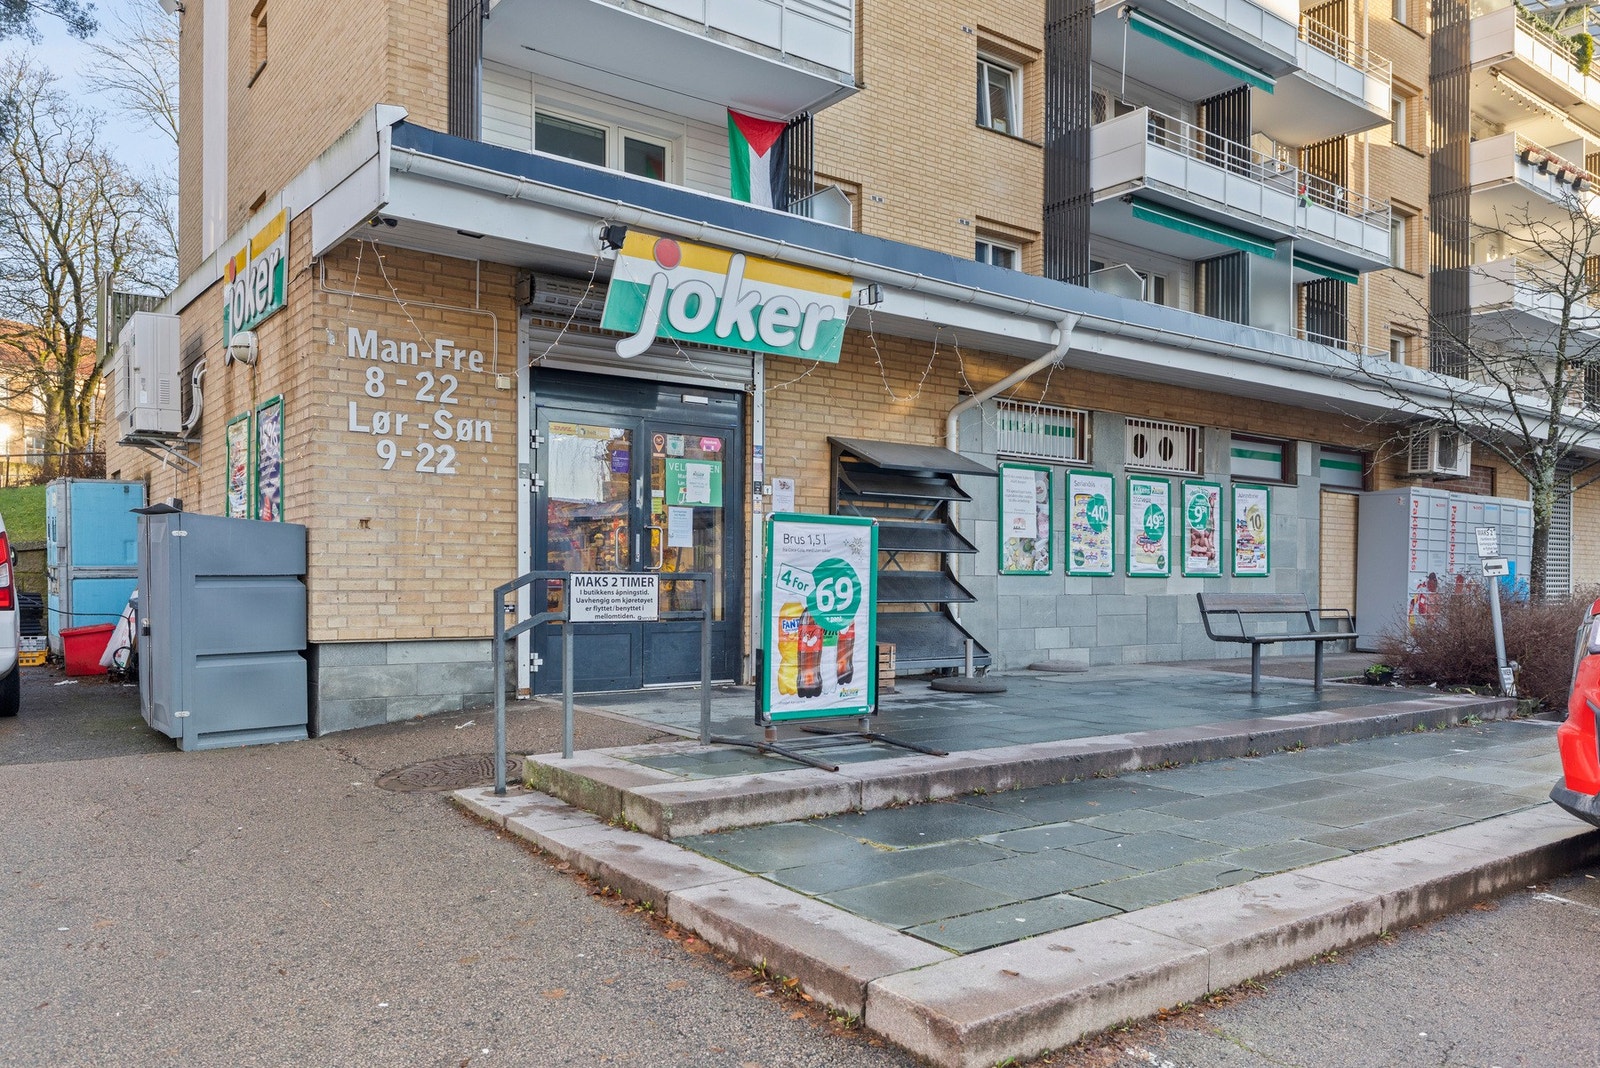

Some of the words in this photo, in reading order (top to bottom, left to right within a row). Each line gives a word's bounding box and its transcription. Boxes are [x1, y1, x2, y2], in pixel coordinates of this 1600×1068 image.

[225, 239, 280, 366] joker
[615, 238, 836, 359] joker
[783, 533, 805, 545] Brus
[808, 534, 821, 546] 1,5
[574, 576, 609, 588] MAKS
[611, 577, 618, 588] 2
[620, 577, 654, 587] TIMER
[781, 569, 792, 586] 4
[792, 576, 810, 592] for
[576, 597, 610, 605] Uavhengig
[622, 597, 654, 605] kjøretøyet
[815, 576, 854, 613] 69
[782, 618, 801, 629] FANT
